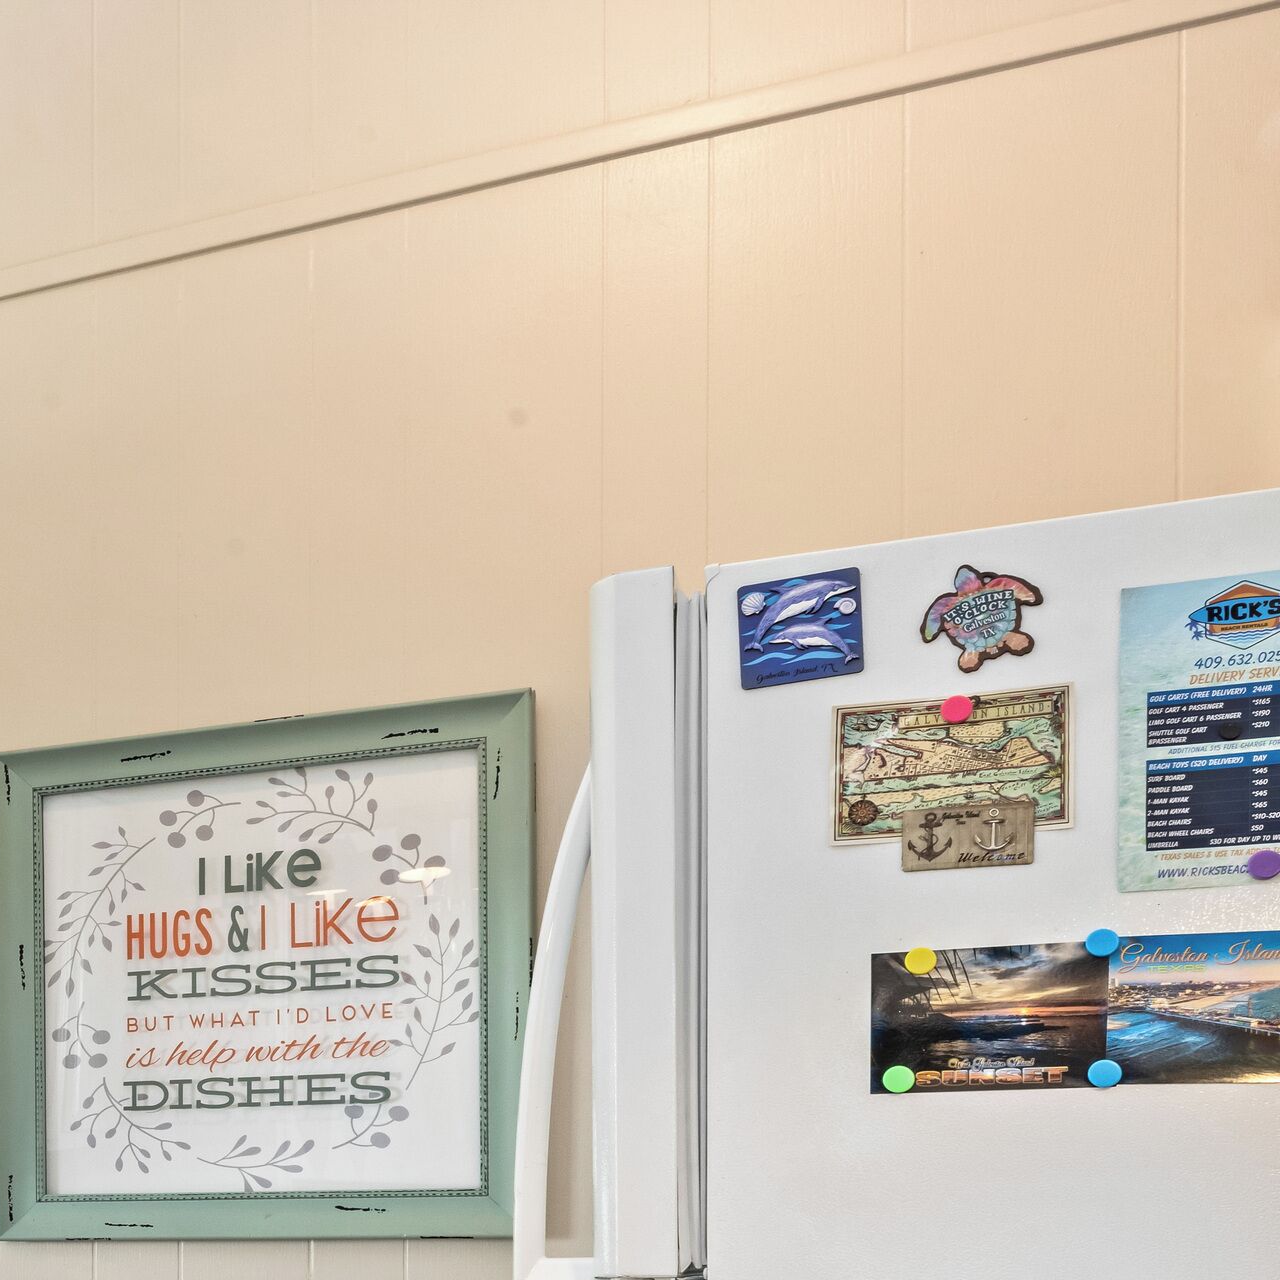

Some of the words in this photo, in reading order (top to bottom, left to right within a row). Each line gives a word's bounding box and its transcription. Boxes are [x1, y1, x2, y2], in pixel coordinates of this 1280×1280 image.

[972, 591, 1013, 604] WINE
[1206, 599, 1280, 622] RICK'S
[964, 612, 1005, 632] Galveston
[981, 628, 996, 638] TX
[1190, 670, 1246, 685] DELIVERY
[1150, 694, 1166, 702] GOLF
[1191, 691, 1210, 699] (FREE
[1211, 687, 1246, 697] DELIVERY)
[1252, 684, 1272, 693] 24HR
[1188, 702, 1224, 711] PASSENGER
[904, 710, 988, 726] GALVON
[1206, 712, 1242, 721] PASSENGER
[1148, 729, 1173, 737] SHUTTLE
[1175, 727, 1190, 735] GOLF
[1168, 746, 1207, 755] ADDITIONAL
[1149, 762, 1170, 771] BEACH
[1209, 756, 1244, 766] DELIVERY)
[1253, 754, 1267, 762] DAY
[1148, 786, 1171, 794] PADDLE
[1168, 818, 1192, 826] CHAIRS
[1147, 831, 1167, 839] BEACH
[1147, 841, 1179, 849] UMBRELLA
[958, 851, 1025, 863] Welcome
[1161, 852, 1181, 861] TEXAS
[1183, 851, 1203, 859] SALES
[198, 858, 206, 895] I
[126, 908, 213, 960] HUGS
[228, 904, 249, 952] &
[260, 904, 266, 950] I
[1118, 942, 1209, 974] Galveston
[1148, 964, 1206, 974] TEXAS
[127, 955, 400, 1001] KISSES
[127, 1016, 174, 1032] BUT
[190, 1010, 260, 1028] WHAT
[276, 1008, 309, 1025] I'D
[326, 1003, 393, 1022] LOVE
[126, 1047, 160, 1069] is
[165, 1040, 236, 1072] help
[245, 1034, 324, 1062] with
[331, 1032, 389, 1058] the
[915, 1065, 1069, 1087] SUNSET
[123, 1071, 392, 1111] DISHES
